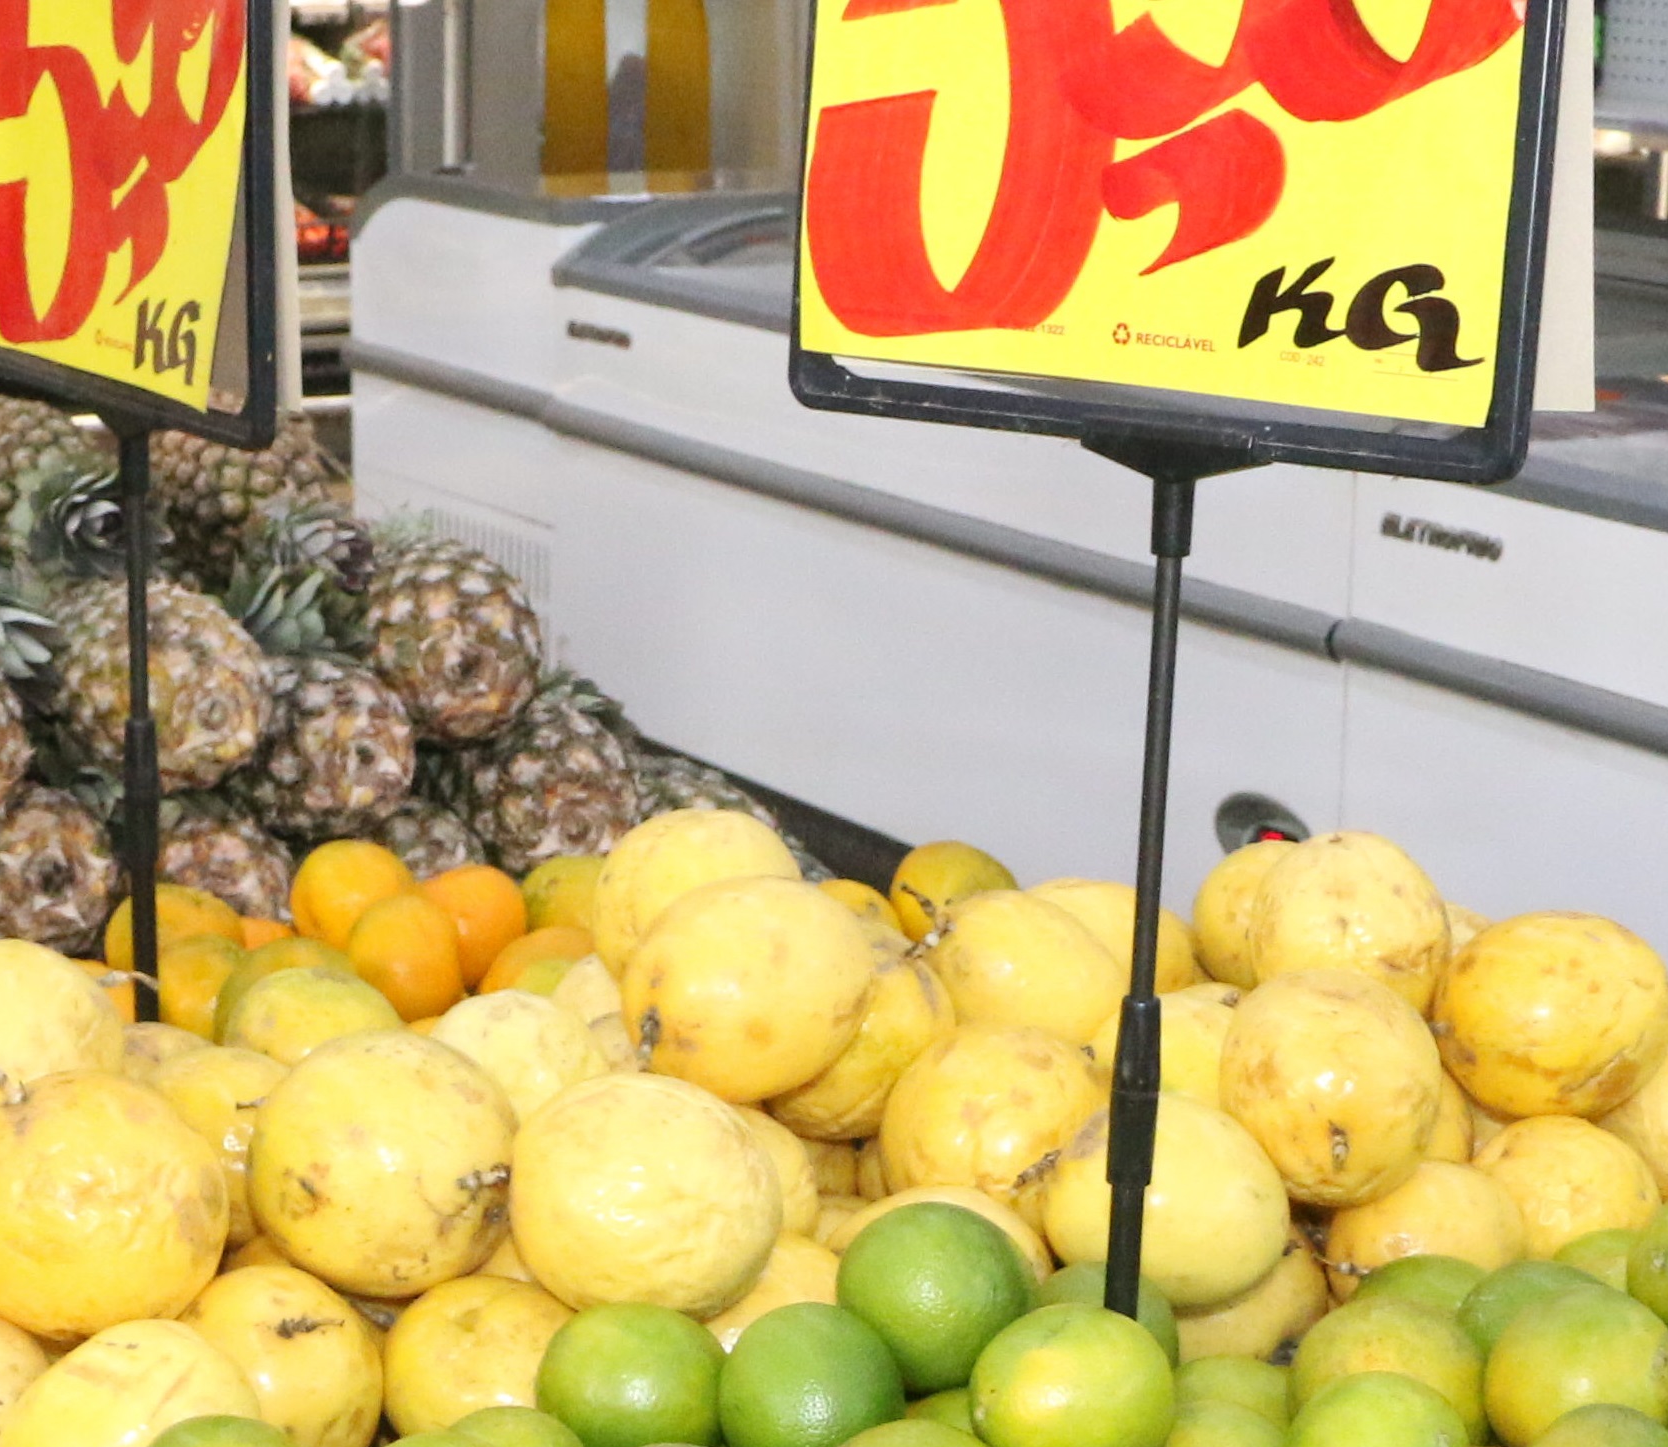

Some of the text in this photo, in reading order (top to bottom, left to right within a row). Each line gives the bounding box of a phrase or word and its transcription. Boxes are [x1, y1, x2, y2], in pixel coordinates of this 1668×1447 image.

[134, 297, 201, 387] KG
[1136, 332, 1216, 352] RECICLÁVEL
[1238, 255, 1485, 371] KG
